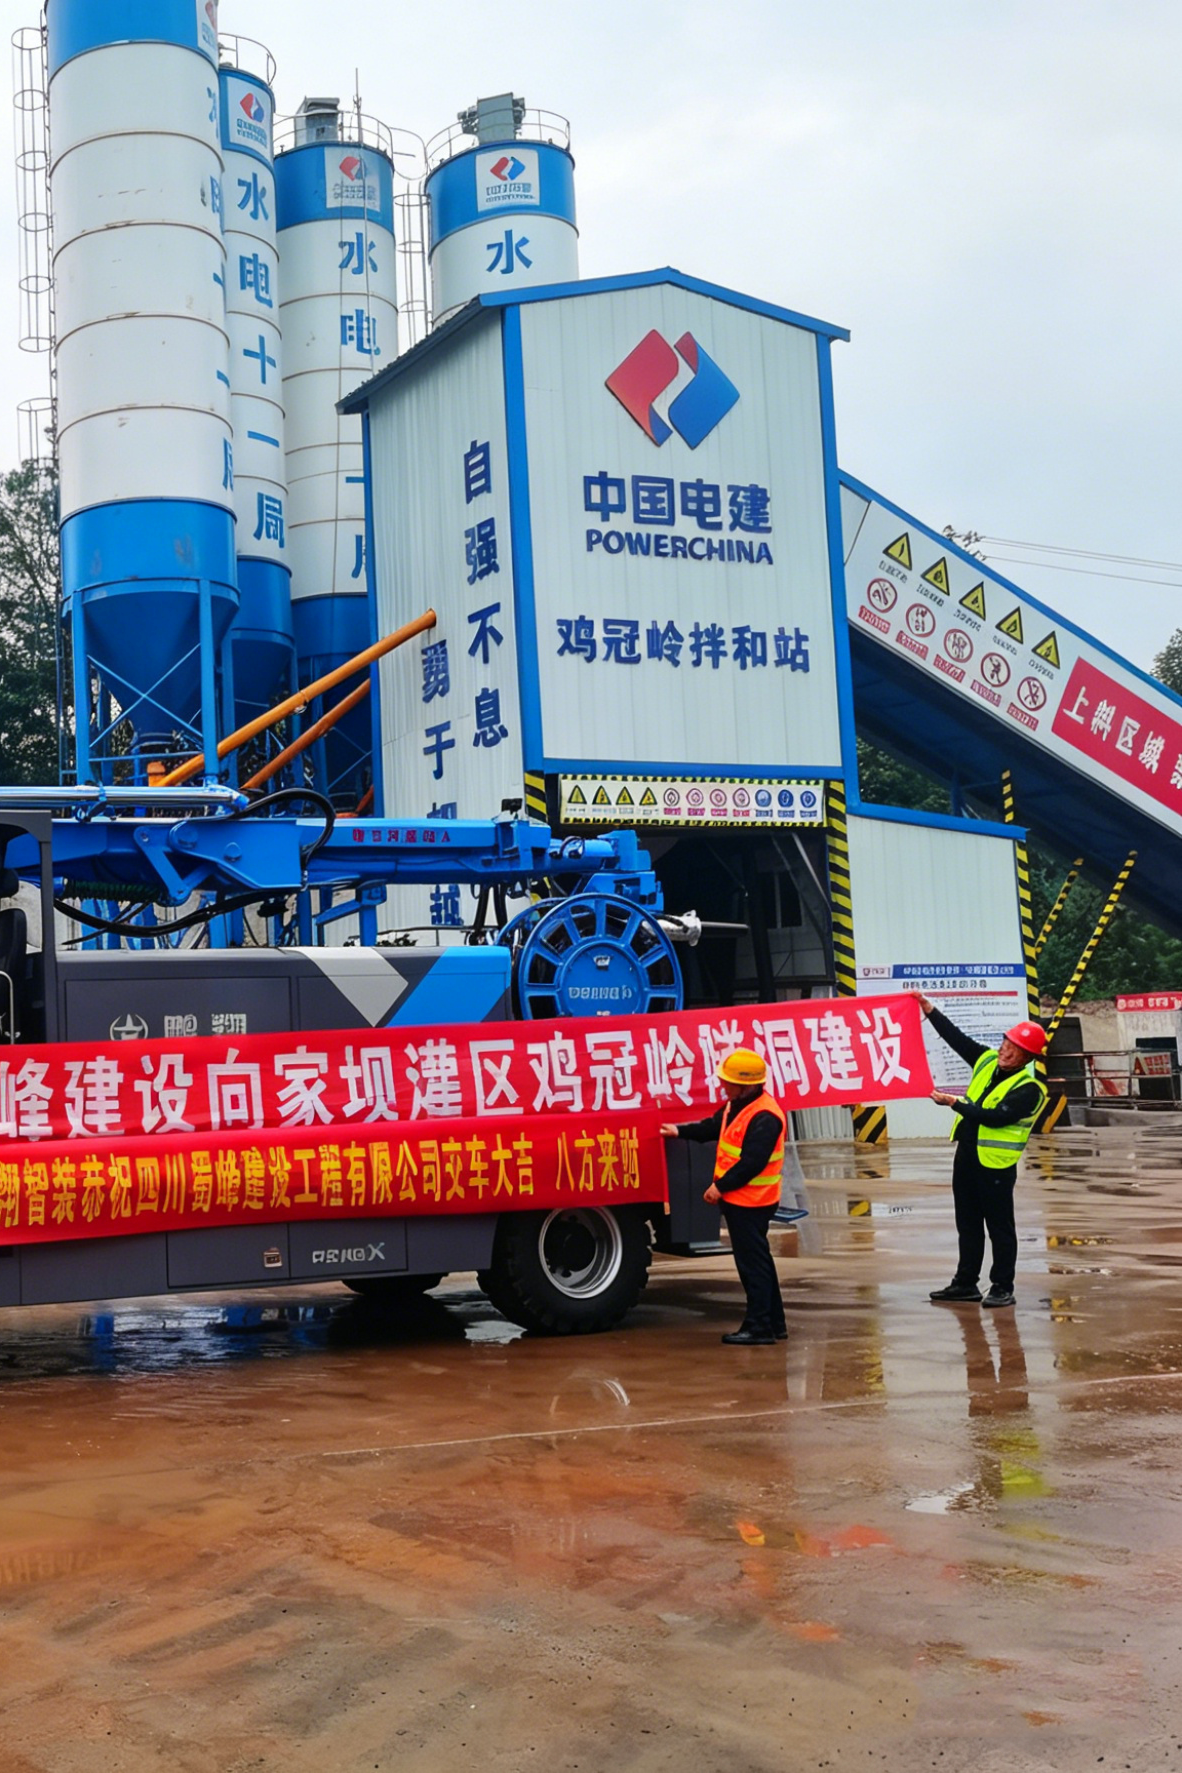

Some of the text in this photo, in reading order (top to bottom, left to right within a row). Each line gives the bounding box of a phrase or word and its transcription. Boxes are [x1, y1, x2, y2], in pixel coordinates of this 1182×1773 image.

[486, 230, 532, 275] 水
[236, 173, 285, 548] 水电十一局
[583, 471, 773, 534] 中国电建
[586, 529, 773, 565] POWERCHINA
[462, 440, 509, 750] 自强不息
[556, 615, 810, 673] 鸡冠岭拌和站
